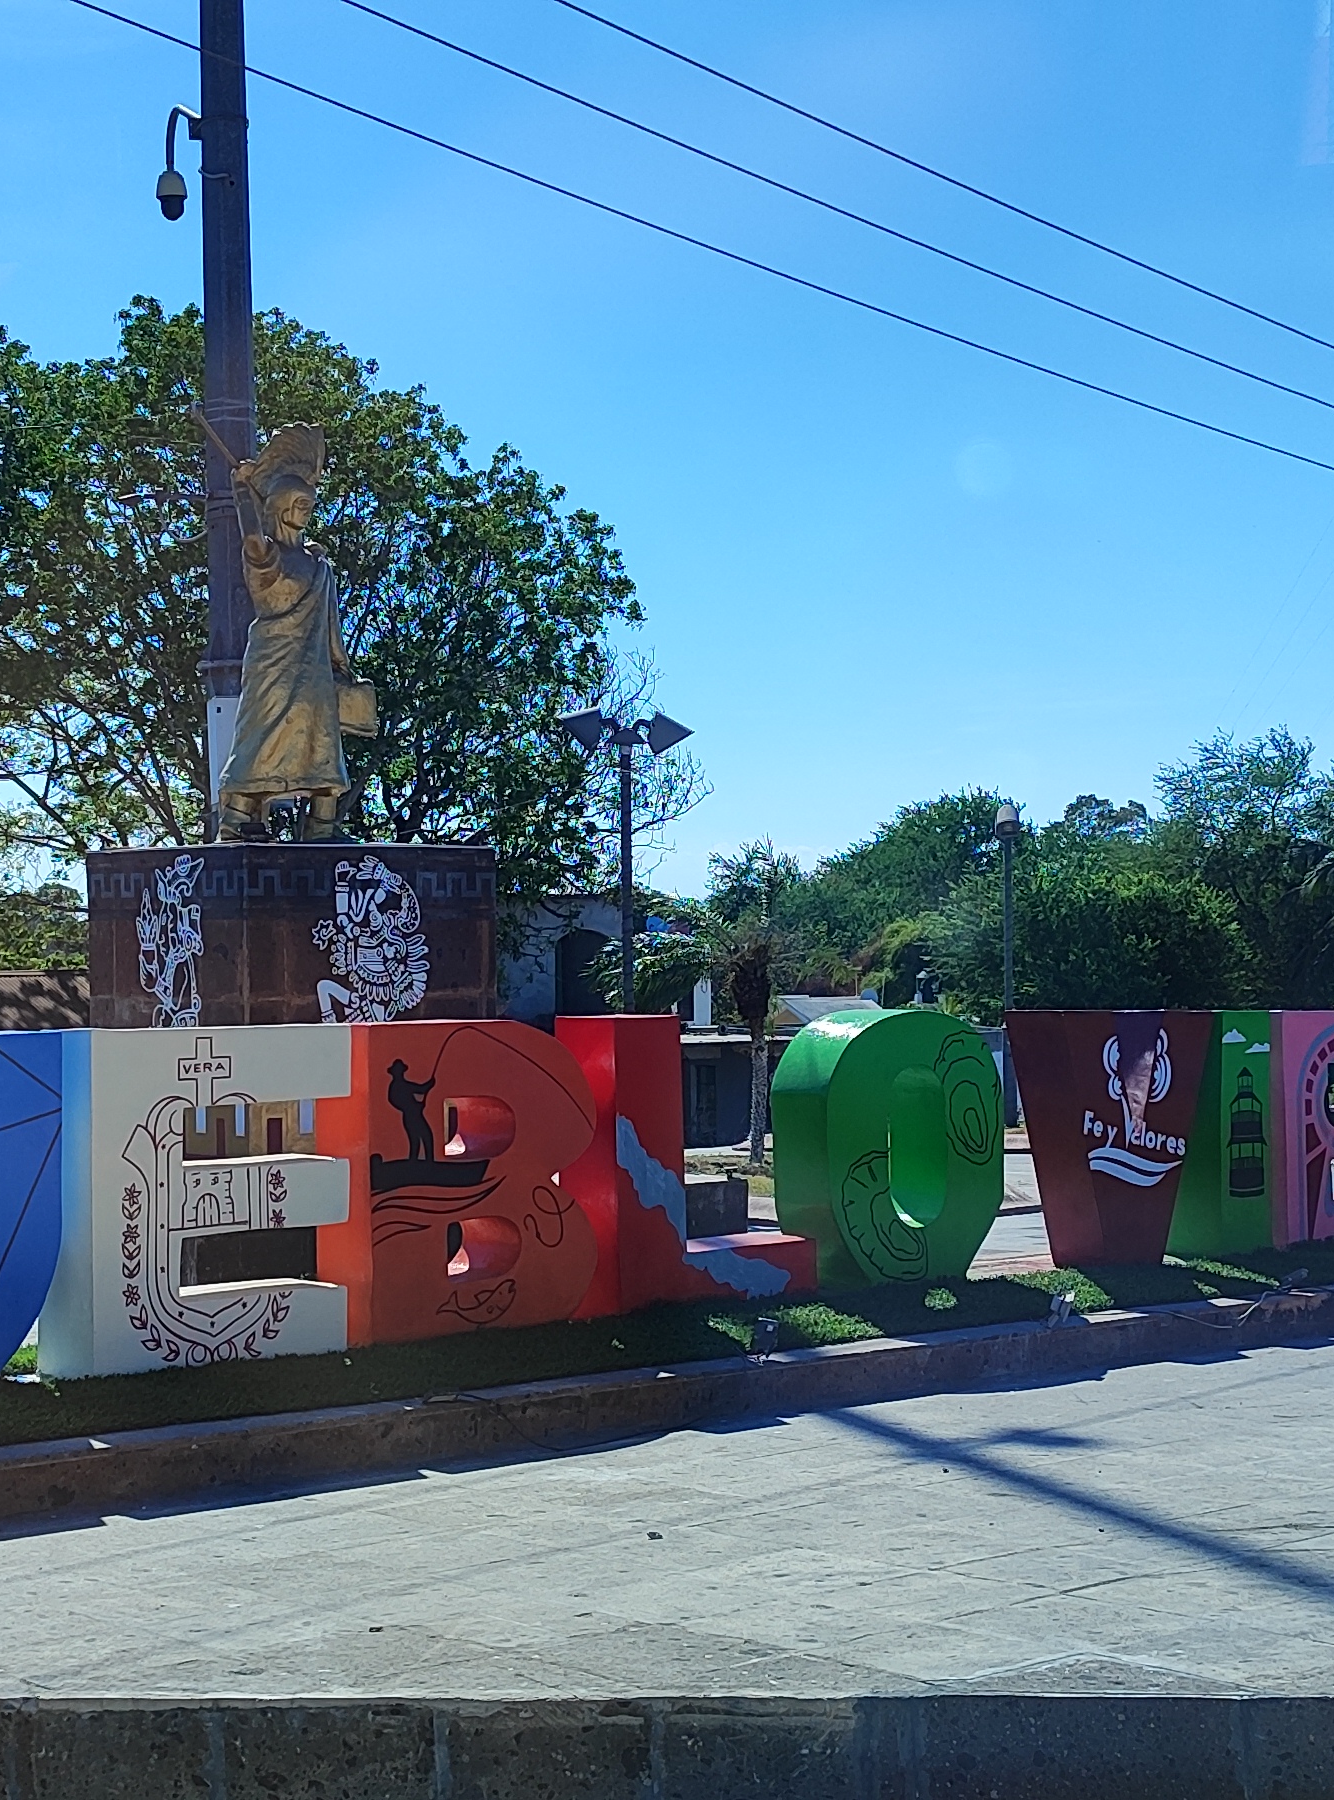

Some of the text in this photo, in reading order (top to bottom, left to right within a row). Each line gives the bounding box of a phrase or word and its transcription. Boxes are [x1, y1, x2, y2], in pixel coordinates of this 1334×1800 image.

[182, 1062, 226, 1075] VERA
[1083, 1097, 1186, 1156] Fe y Valores
